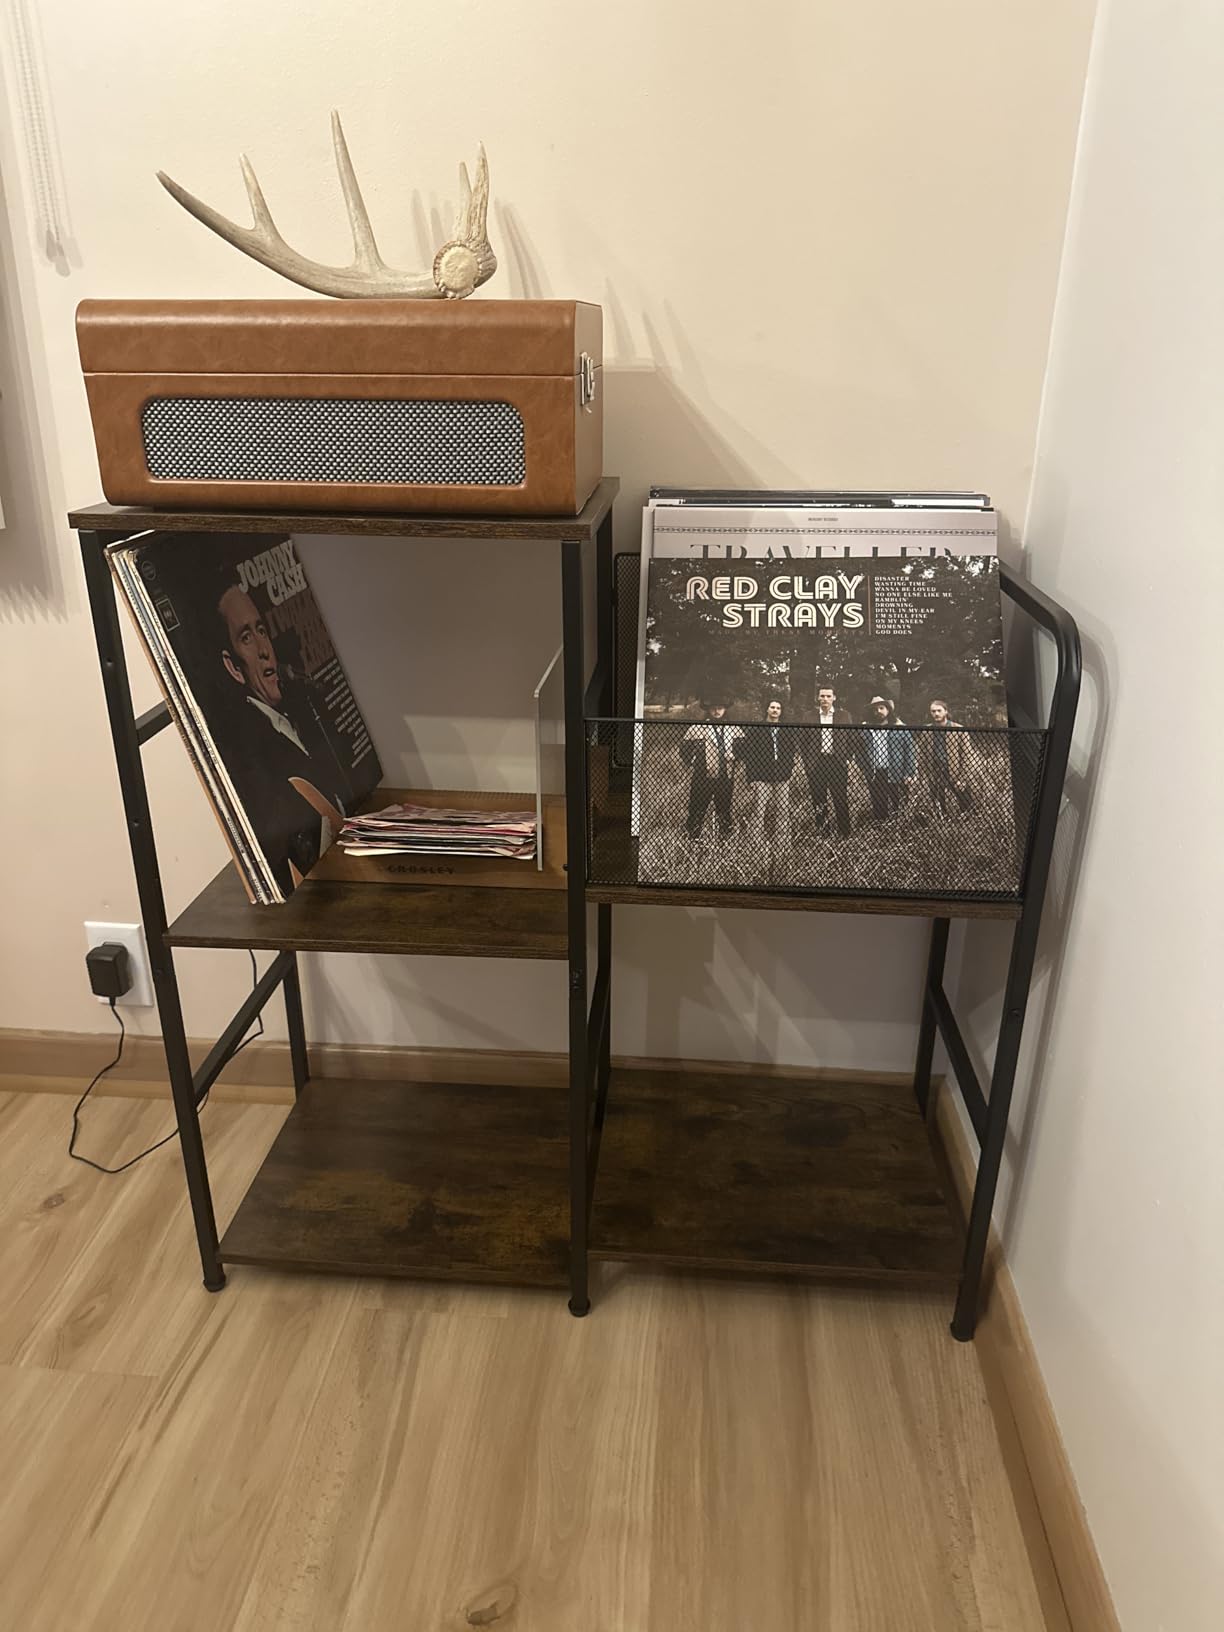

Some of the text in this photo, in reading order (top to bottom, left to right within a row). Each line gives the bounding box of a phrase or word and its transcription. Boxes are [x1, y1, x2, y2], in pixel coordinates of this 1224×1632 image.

[236, 539, 296, 593] JOHNNY
[266, 562, 307, 606] CASH
[686, 575, 864, 600] RED CLAY
[722, 602, 864, 628] STRAYS
